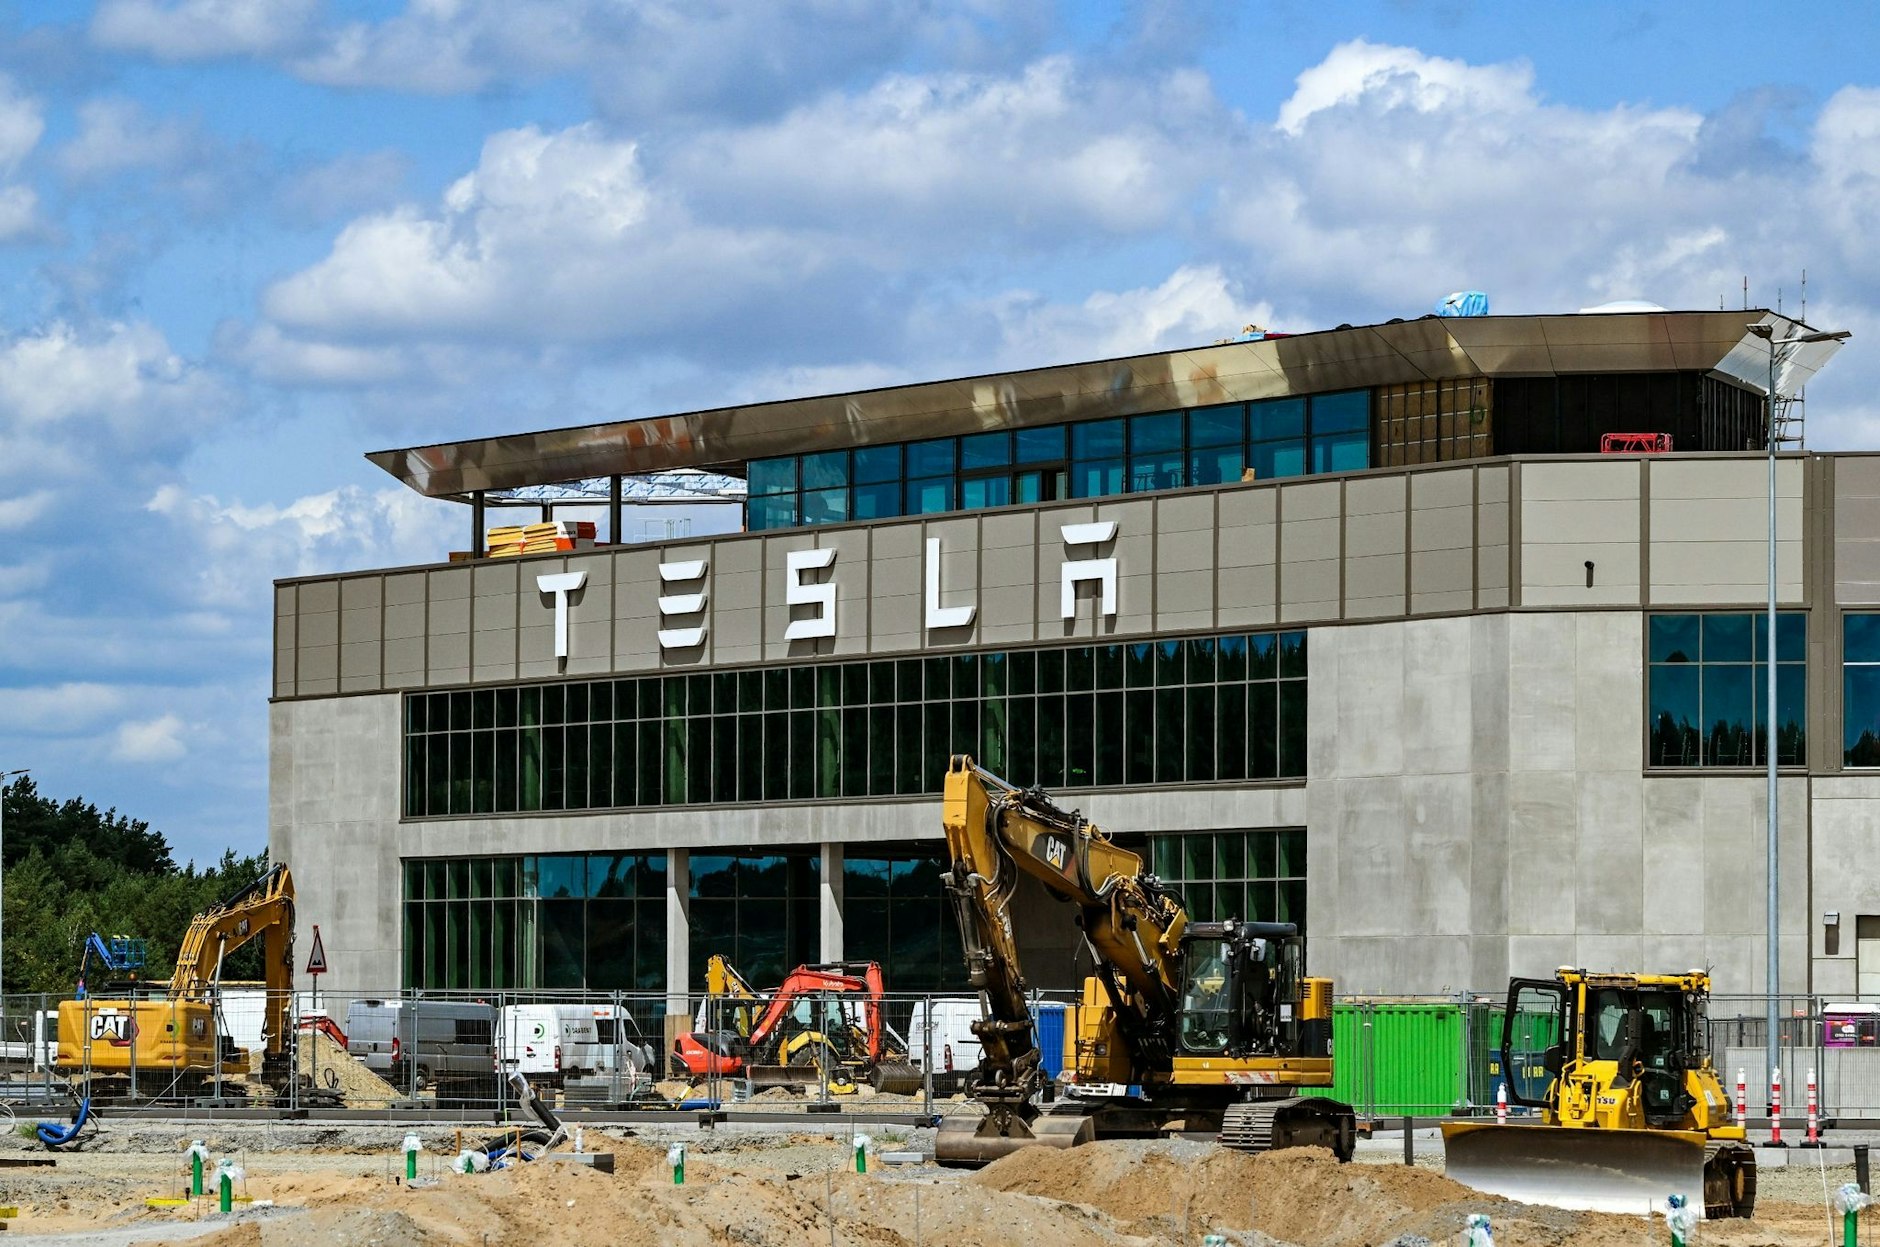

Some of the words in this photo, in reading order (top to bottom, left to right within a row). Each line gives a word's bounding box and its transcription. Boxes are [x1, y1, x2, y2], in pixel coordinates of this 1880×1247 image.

[536, 521, 1118, 657] TESLA
[1046, 835, 1067, 870] CAT
[91, 1015, 128, 1040] CAT
